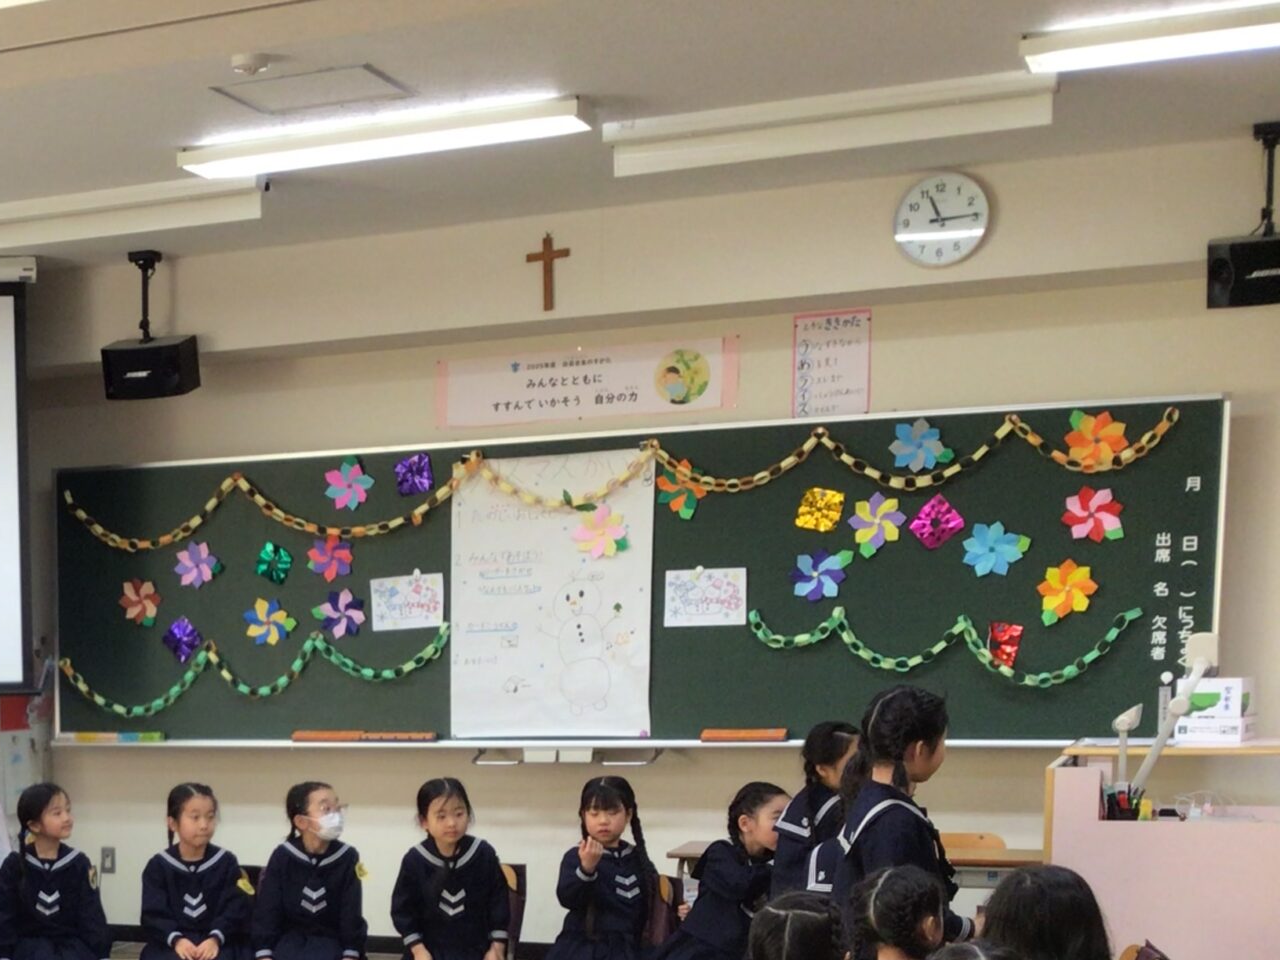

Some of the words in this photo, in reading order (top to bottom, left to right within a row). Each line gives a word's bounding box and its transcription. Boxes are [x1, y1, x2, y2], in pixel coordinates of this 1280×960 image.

[935, 183, 946, 193] 12
[920, 189, 930, 199] 11
[967, 196, 975, 206] 2
[909, 202, 920, 212] 10
[902, 218, 910, 228] 9
[919, 244, 926, 254] 7
[953, 241, 960, 251] 5
[935, 247, 943, 257] 6
[526, 374, 603, 389] みんなとともに
[492, 395, 581, 412] すすんでいかそう
[594, 390, 639, 405] 自分の力
[1185, 476, 1201, 492] 月
[1154, 532, 1172, 563] 出席
[1153, 582, 1169, 597] 名
[1150, 615, 1168, 660] 欠席者
